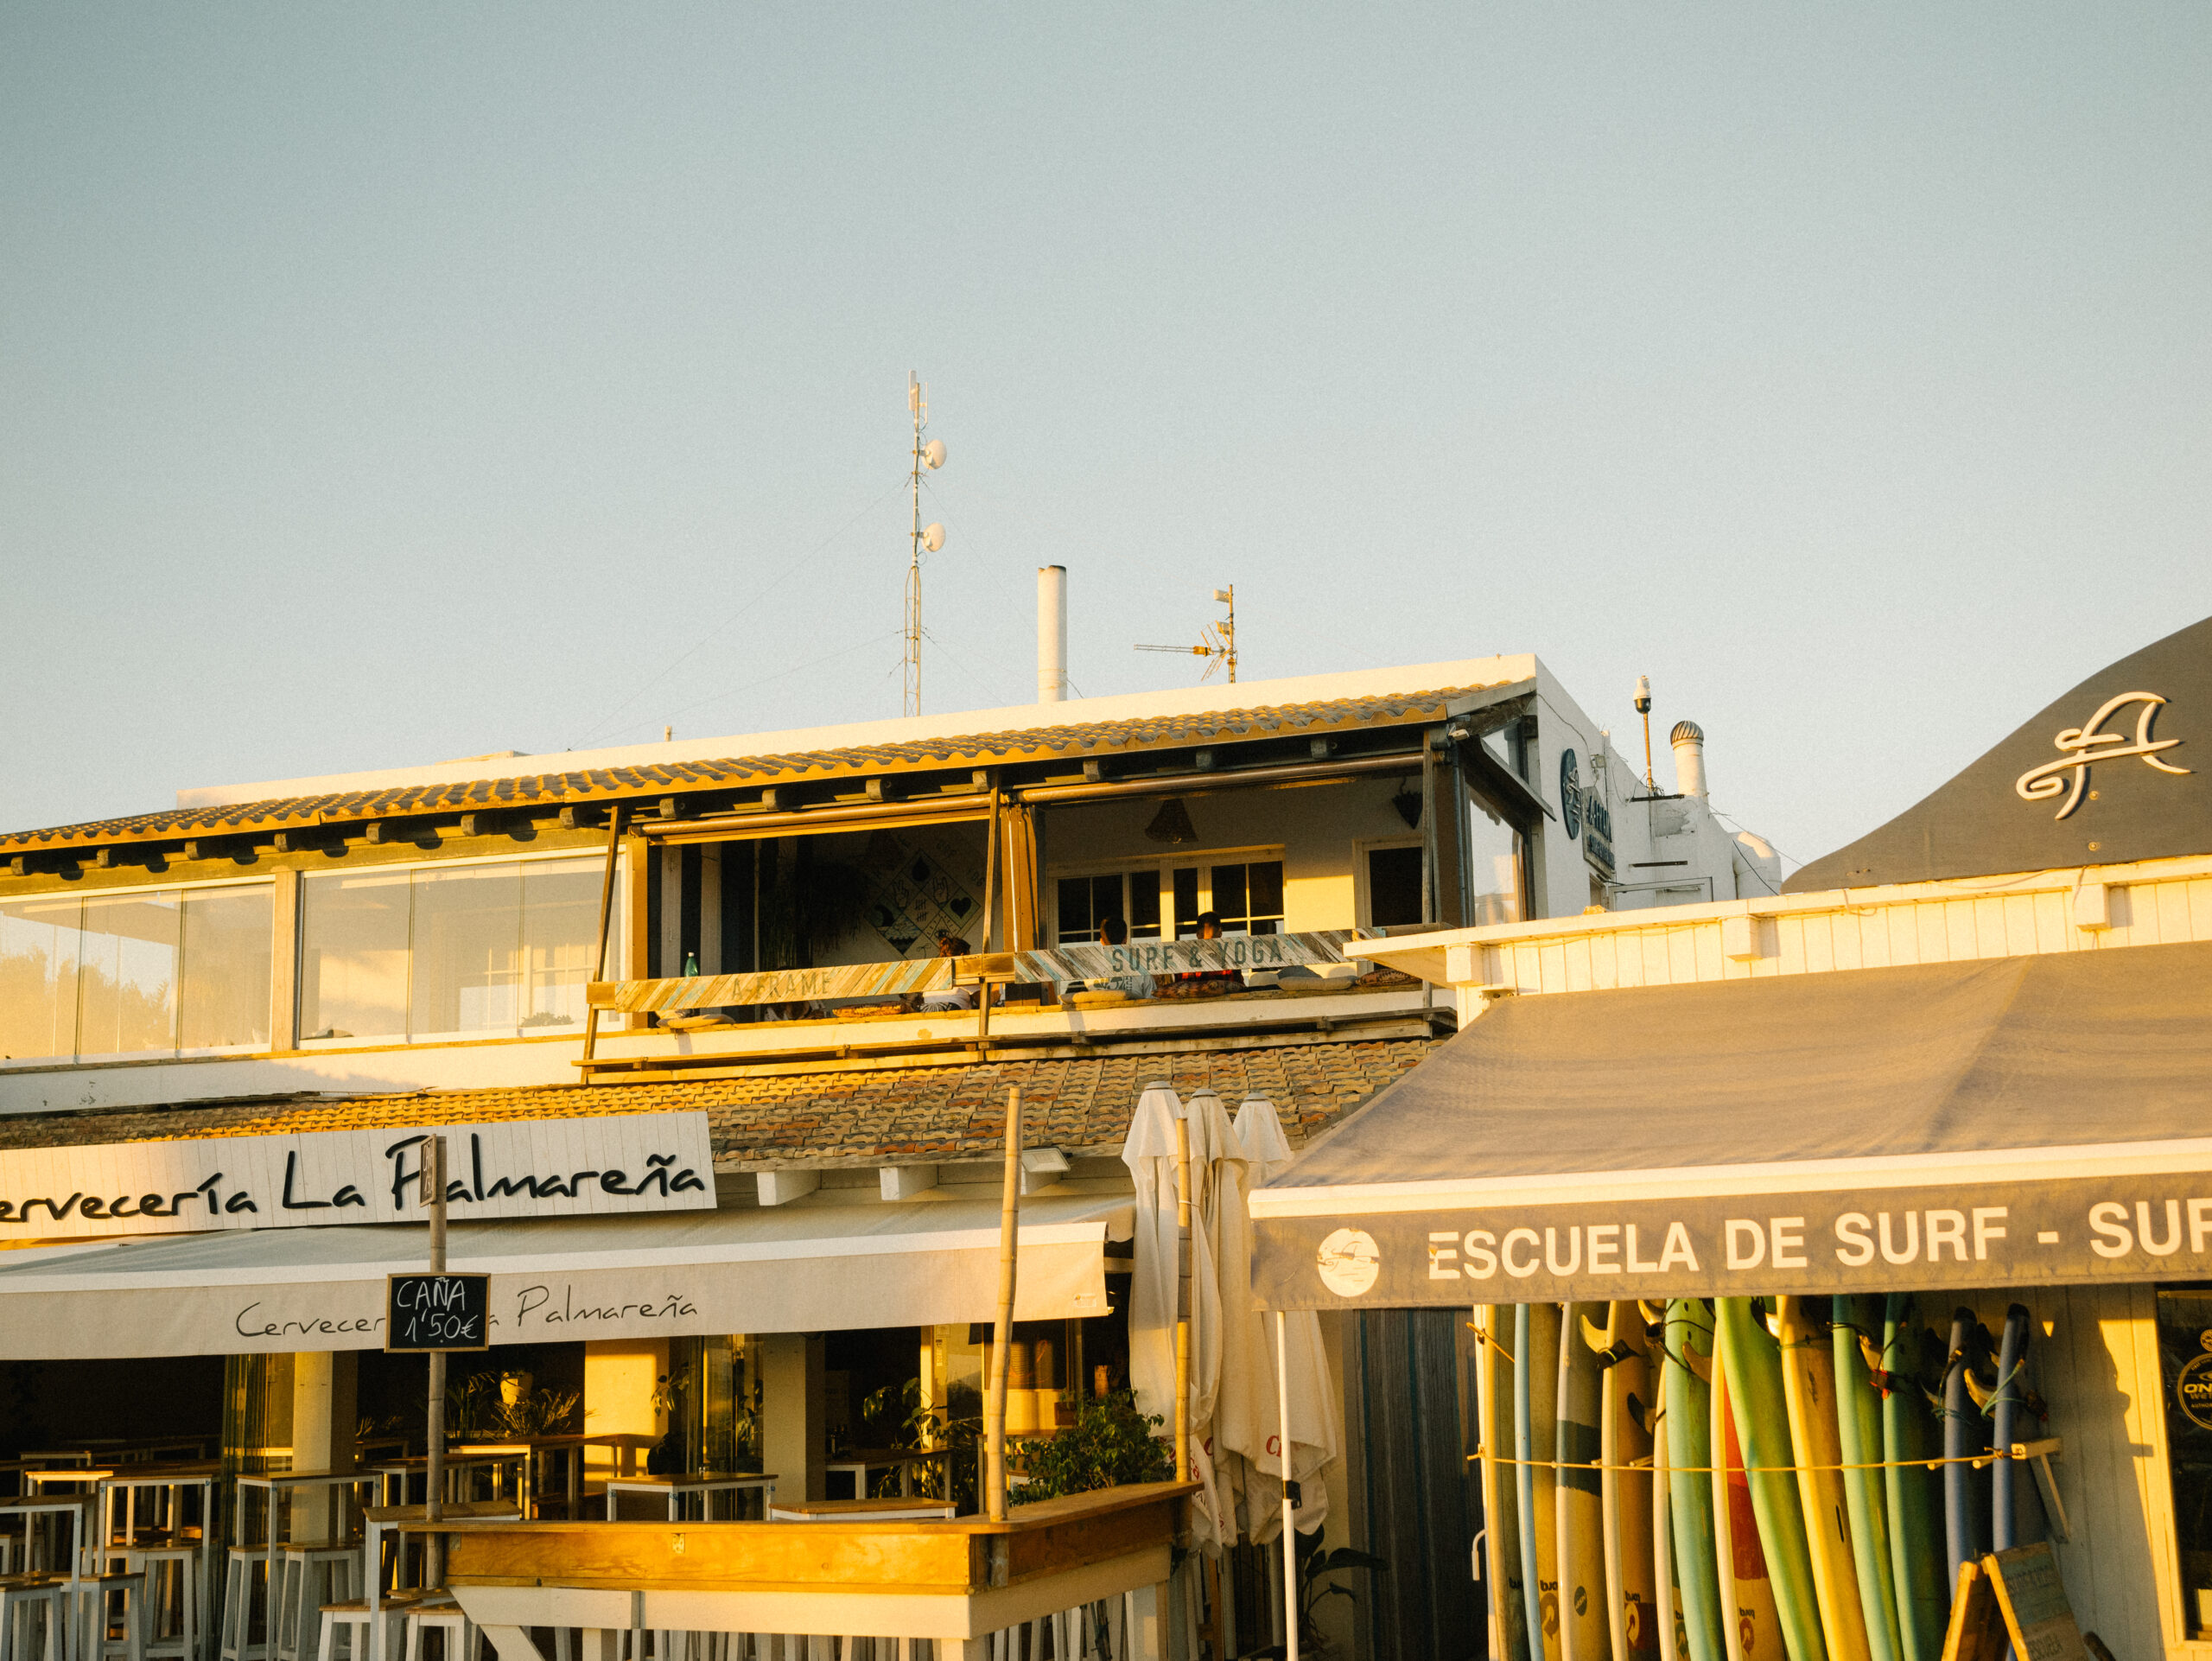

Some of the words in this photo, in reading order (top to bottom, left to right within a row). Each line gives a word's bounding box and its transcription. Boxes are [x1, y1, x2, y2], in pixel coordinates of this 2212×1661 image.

[1112, 945, 1178, 972] SURF
[1188, 946, 1203, 968] &
[1217, 938, 1283, 969] YOGA
[731, 971, 830, 1001] A-FRAME
[0, 1172, 258, 1223] ervecería
[282, 1150, 365, 1209] La
[385, 1132, 705, 1211] Palmareña
[1428, 1221, 1700, 1279] ESCUELA
[1725, 1216, 1808, 1270] DE
[1834, 1206, 2008, 1267] SURF
[236, 1301, 386, 1337] Cervecer
[518, 1284, 698, 1327] Palmareña
[397, 1276, 466, 1312] CAÑA
